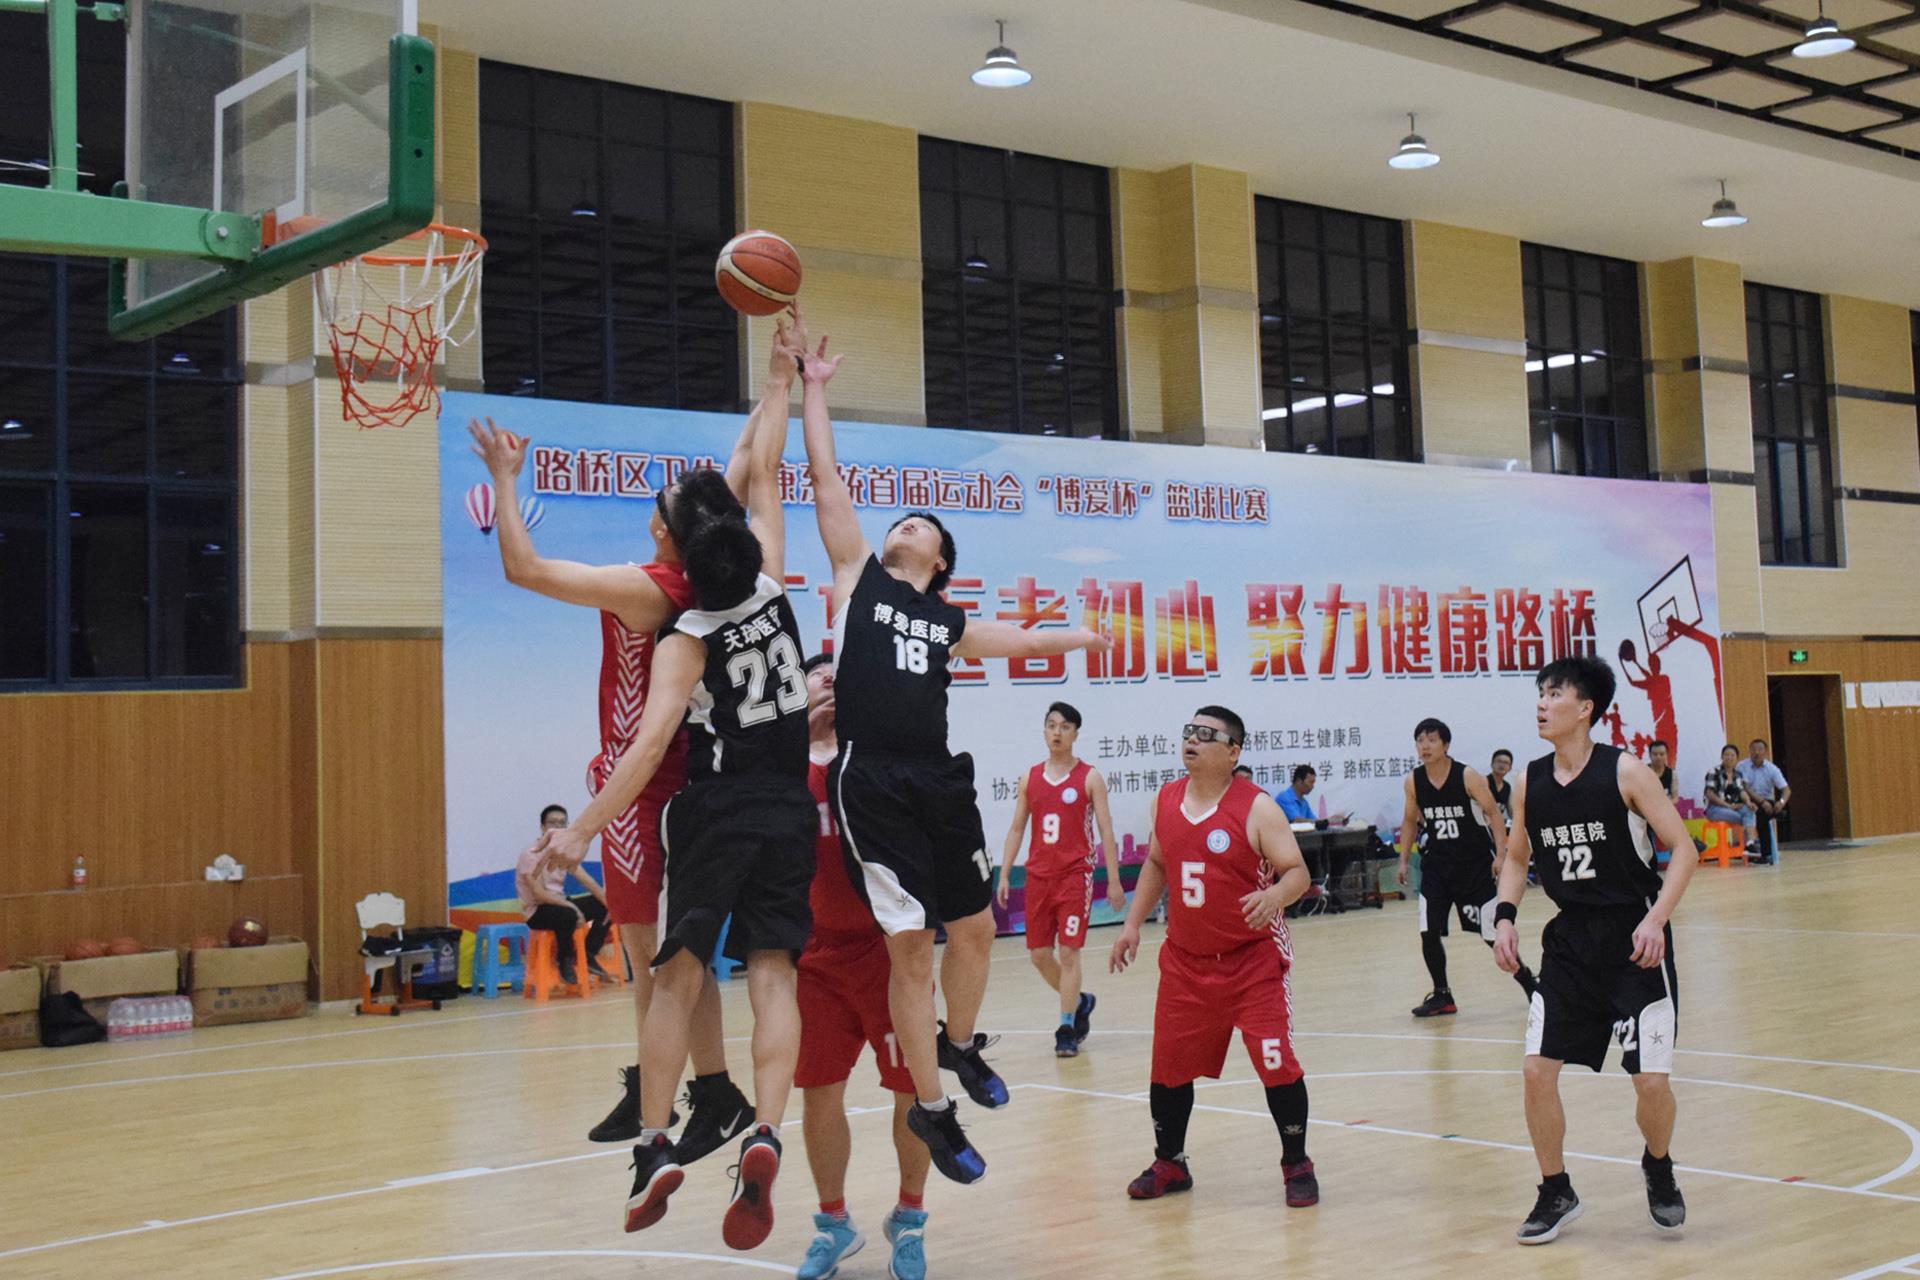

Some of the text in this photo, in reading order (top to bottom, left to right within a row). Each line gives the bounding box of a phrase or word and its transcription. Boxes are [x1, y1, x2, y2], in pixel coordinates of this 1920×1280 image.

[1167, 483, 1270, 522] 篮球比赛
[873, 601, 950, 646] 博爱医院
[1244, 582, 1600, 681] 聚力健康路桥
[892, 633, 929, 676] 18
[725, 630, 809, 729] 23
[1343, 755, 1423, 781] 路桥区篮球
[1042, 812, 1060, 845] 9
[1423, 805, 1466, 820] 博爱医院
[1434, 818, 1461, 841] 20
[1540, 820, 1607, 848] 博爱医院
[1557, 844, 1598, 882] 22
[1181, 860, 1207, 909] 5
[1065, 914, 1081, 938] 9
[1261, 1037, 1282, 1071] 5
